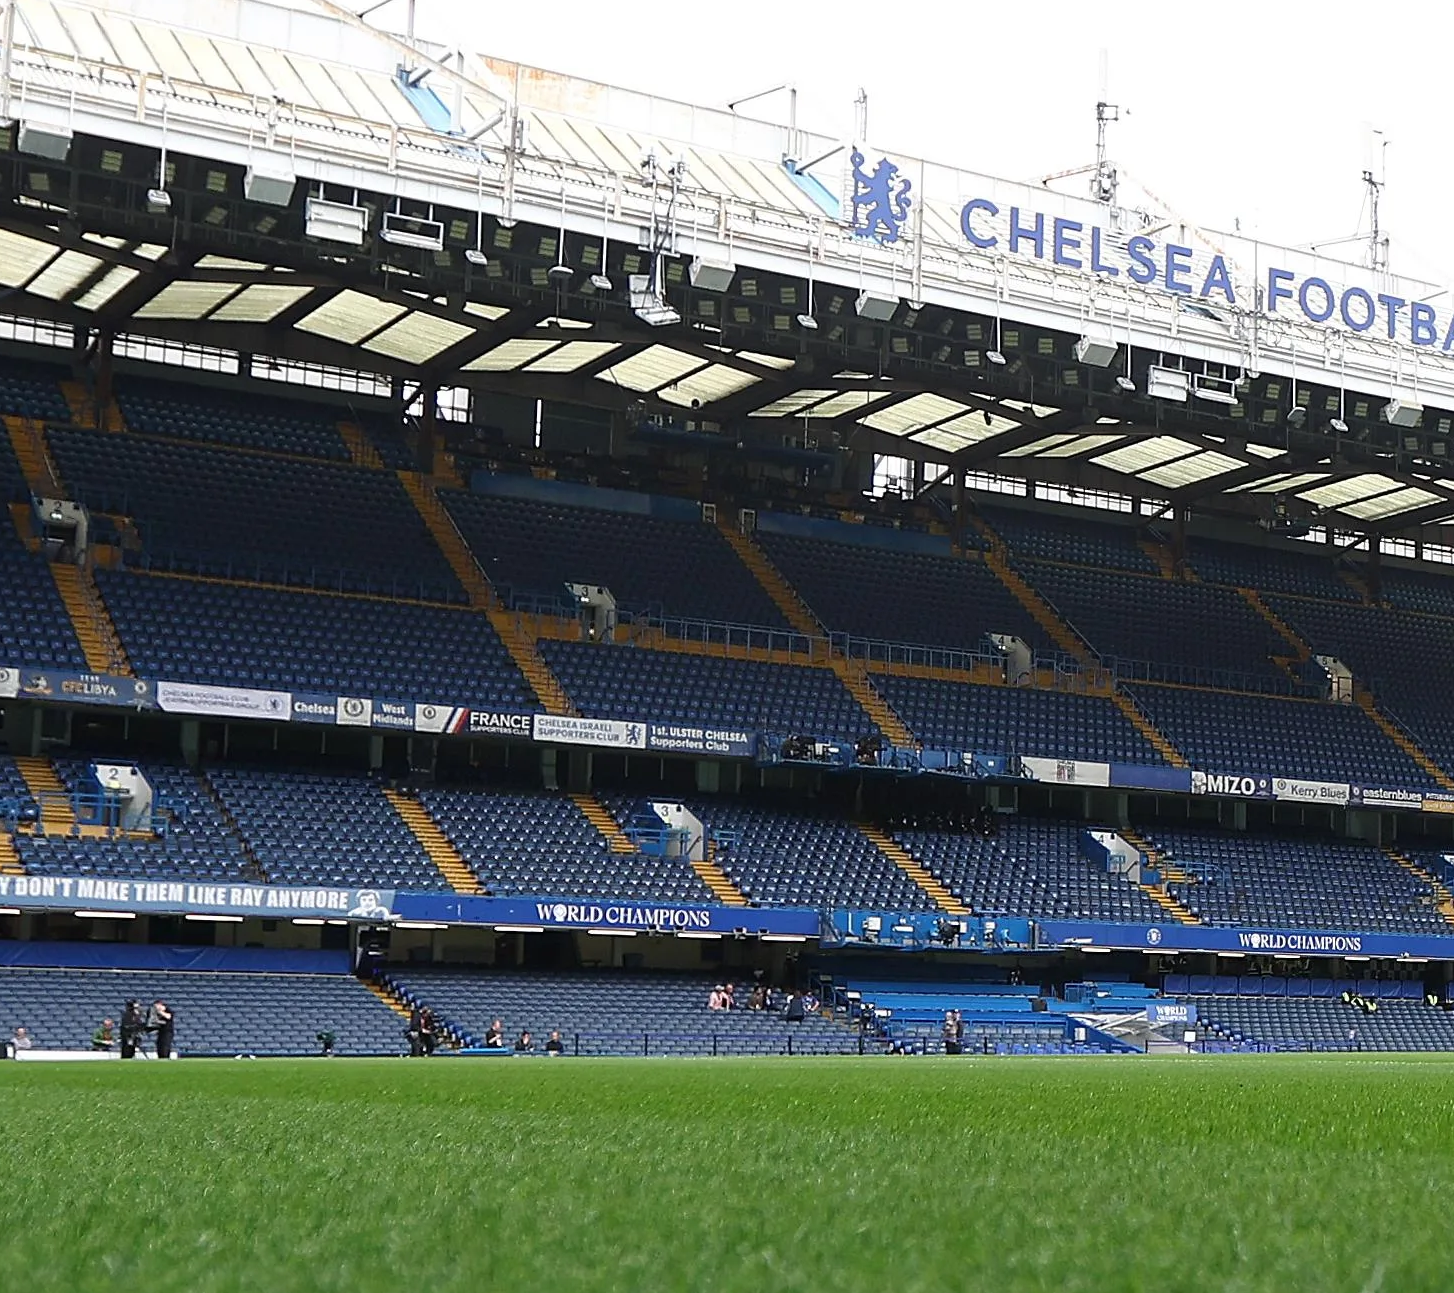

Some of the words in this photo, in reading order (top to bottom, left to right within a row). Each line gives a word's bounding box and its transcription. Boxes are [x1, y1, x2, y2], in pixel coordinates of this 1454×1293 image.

[960, 197, 1236, 305] CHELSEA
[54, 501, 62, 513] 2
[581, 586, 589, 597] 3
[294, 701, 335, 715] Chelsea
[382, 702, 406, 715] West
[373, 712, 414, 726] Midlands
[470, 711, 531, 729] FRANCE
[538, 718, 577, 730] CHELSEA
[580, 720, 612, 732] ISRAELI
[470, 724, 512, 734] SUPPORTERS
[512, 727, 530, 736] CLUB
[538, 728, 595, 740] SUPPORTERS
[597, 732, 620, 742] CLUB
[670, 727, 703, 739] ULSTER
[705, 730, 748, 743] CHELSEA
[650, 736, 703, 750] Supporters
[706, 740, 730, 751] Club
[109, 767, 118, 781] 2
[1207, 774, 1256, 796] MIZO
[1291, 785, 1318, 798] Kerry
[1321, 787, 1347, 799] Blues
[1363, 788, 1422, 802] easternblues
[660, 806, 670, 817] 3
[15, 876, 73, 898] DON'T
[77, 879, 130, 901] MAKE
[134, 882, 184, 904] THEM
[187, 885, 227, 906] LIKE
[230, 888, 265, 908] RAY
[266, 889, 348, 910] ANYMORE
[605, 907, 710, 927] CHAMPIONS
[1287, 935, 1362, 951] CHAMPIONS
